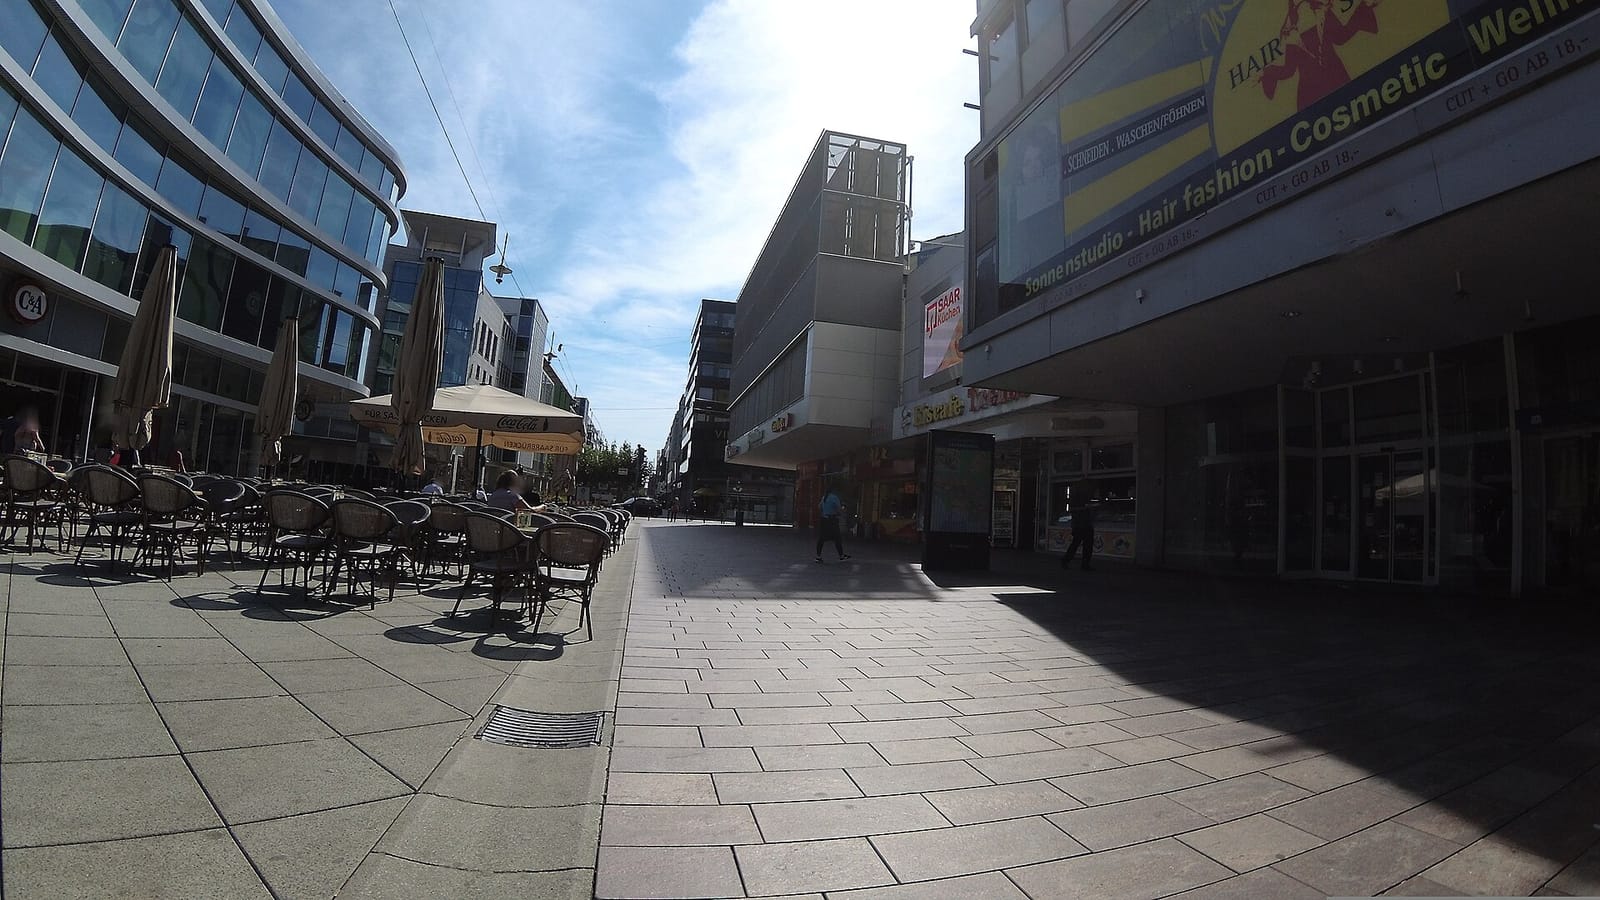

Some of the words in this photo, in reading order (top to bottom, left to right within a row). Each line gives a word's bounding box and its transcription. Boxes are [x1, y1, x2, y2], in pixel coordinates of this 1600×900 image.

[1229, 38, 1284, 89] HAIR
[1445, 86, 1475, 112] CUT
[1495, 65, 1520, 88] GO
[1526, 51, 1550, 75] AB
[1555, 37, 1590, 59] 18,-
[1067, 139, 1110, 174] SCHNEIDEN
[1115, 95, 1207, 150] WASCHEN/FÖHNEN
[1024, 230, 1124, 297] Sonnenstudio
[1138, 198, 1179, 237] Hair
[1183, 148, 1273, 214] fashion
[1290, 50, 1449, 154] Cosmetic
[1255, 184, 1278, 206] CUT
[1291, 170, 1309, 188] GO
[1313, 159, 1331, 178] AB
[1167, 234, 1179, 250] AB
[19, 289, 42, 316] C&A
[937, 287, 960, 313] SAAR
[937, 304, 961, 327] Küchen
